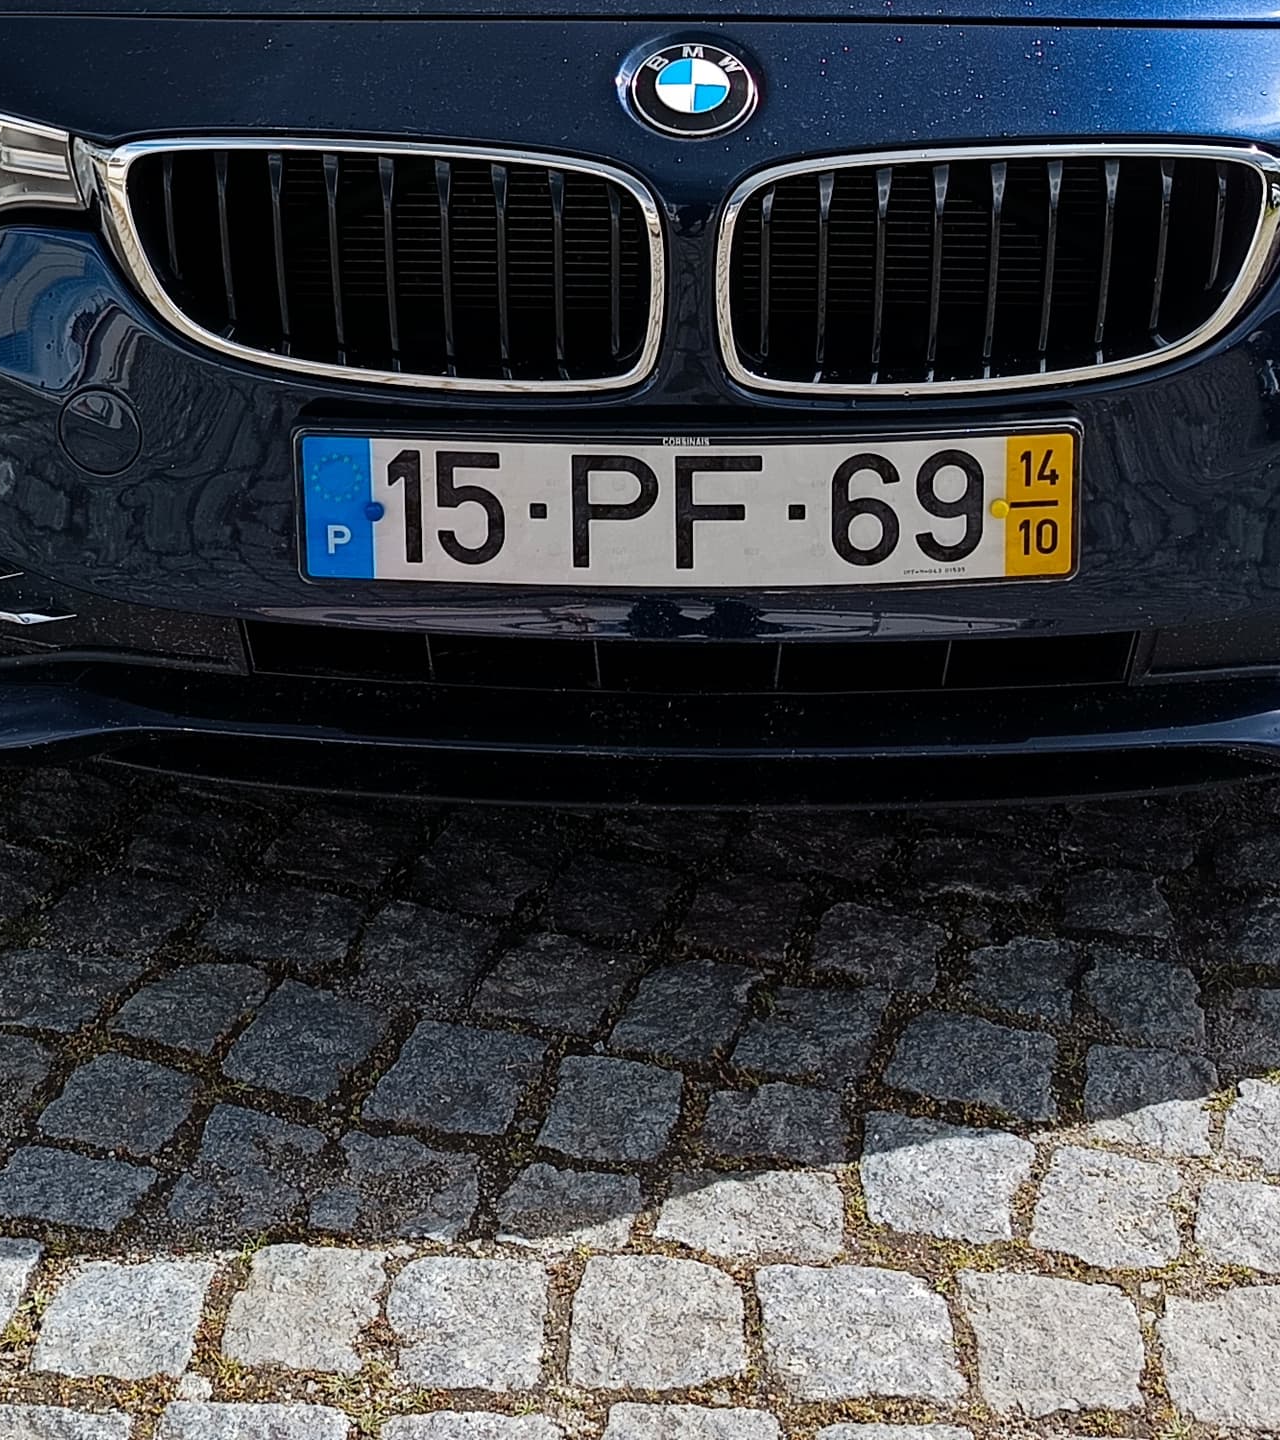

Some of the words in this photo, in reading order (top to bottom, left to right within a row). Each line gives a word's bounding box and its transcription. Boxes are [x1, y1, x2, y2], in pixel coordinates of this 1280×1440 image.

[645, 45, 744, 73] BMW
[1020, 449, 1060, 487] 14
[327, 524, 352, 555] P
[1018, 518, 1059, 557] 10
